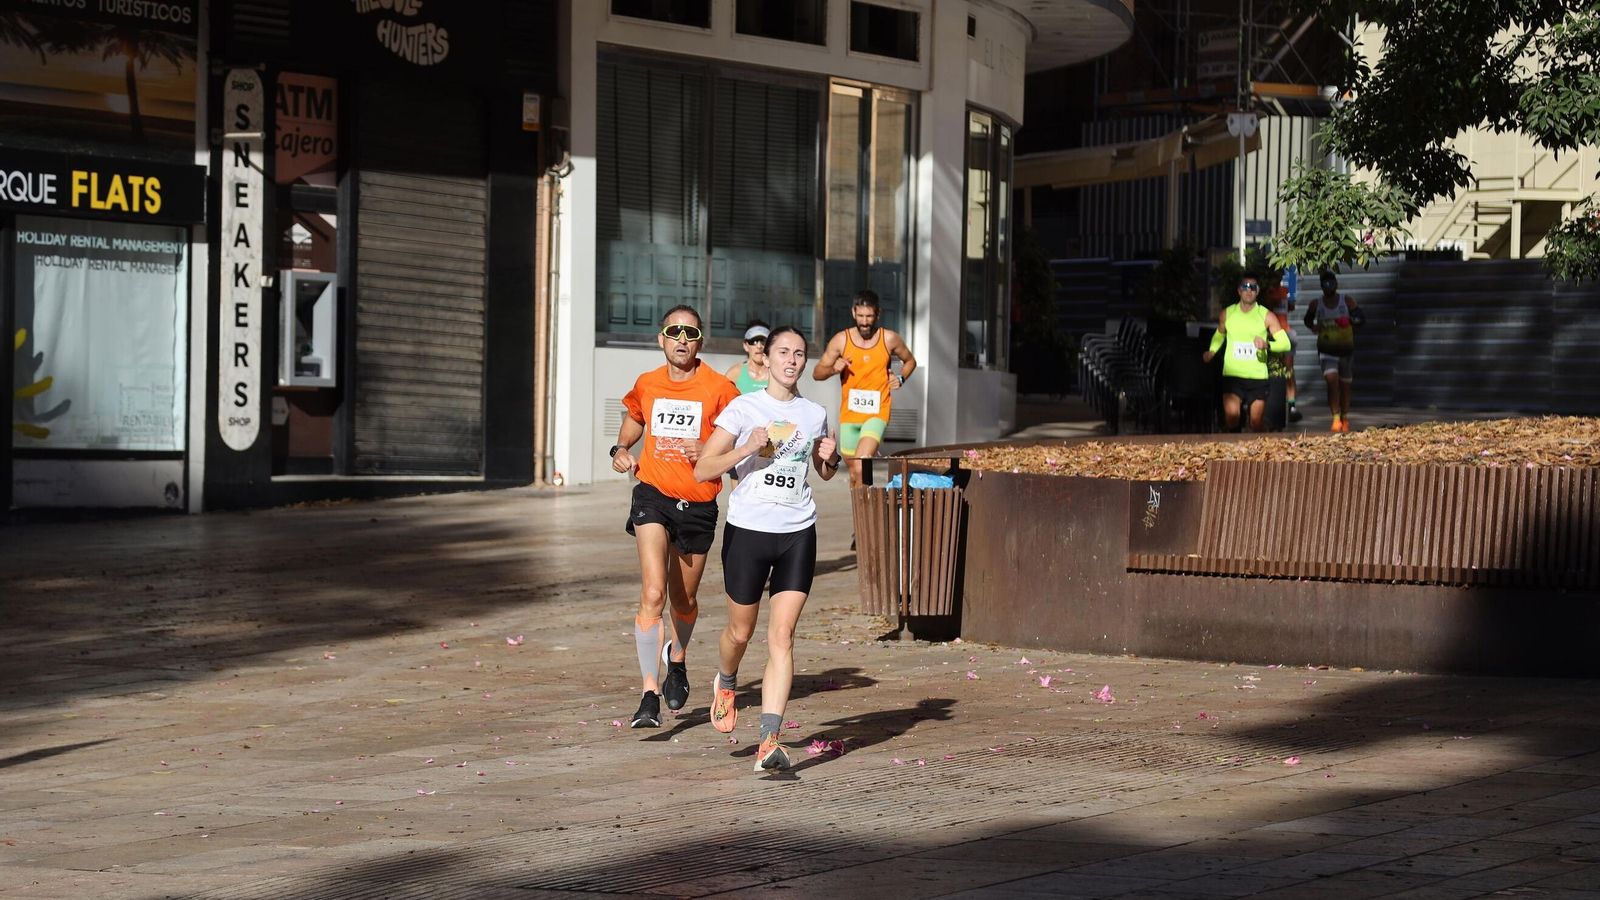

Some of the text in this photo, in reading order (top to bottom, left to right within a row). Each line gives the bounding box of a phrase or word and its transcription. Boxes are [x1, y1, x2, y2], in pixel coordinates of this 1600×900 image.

[376, 19, 449, 66] HUNTERS
[232, 80, 254, 92] SHOP
[275, 83, 333, 120] ATM
[71, 170, 162, 214] FLATS
[17, 231, 184, 254] HOLIDAY RENTAL MANAGEMENT
[234, 104, 250, 407] SNEAKERS
[853, 397, 874, 406] 334
[228, 416, 251, 427] SHOP
[657, 412, 695, 426] 1737
[763, 473, 796, 489] 993
